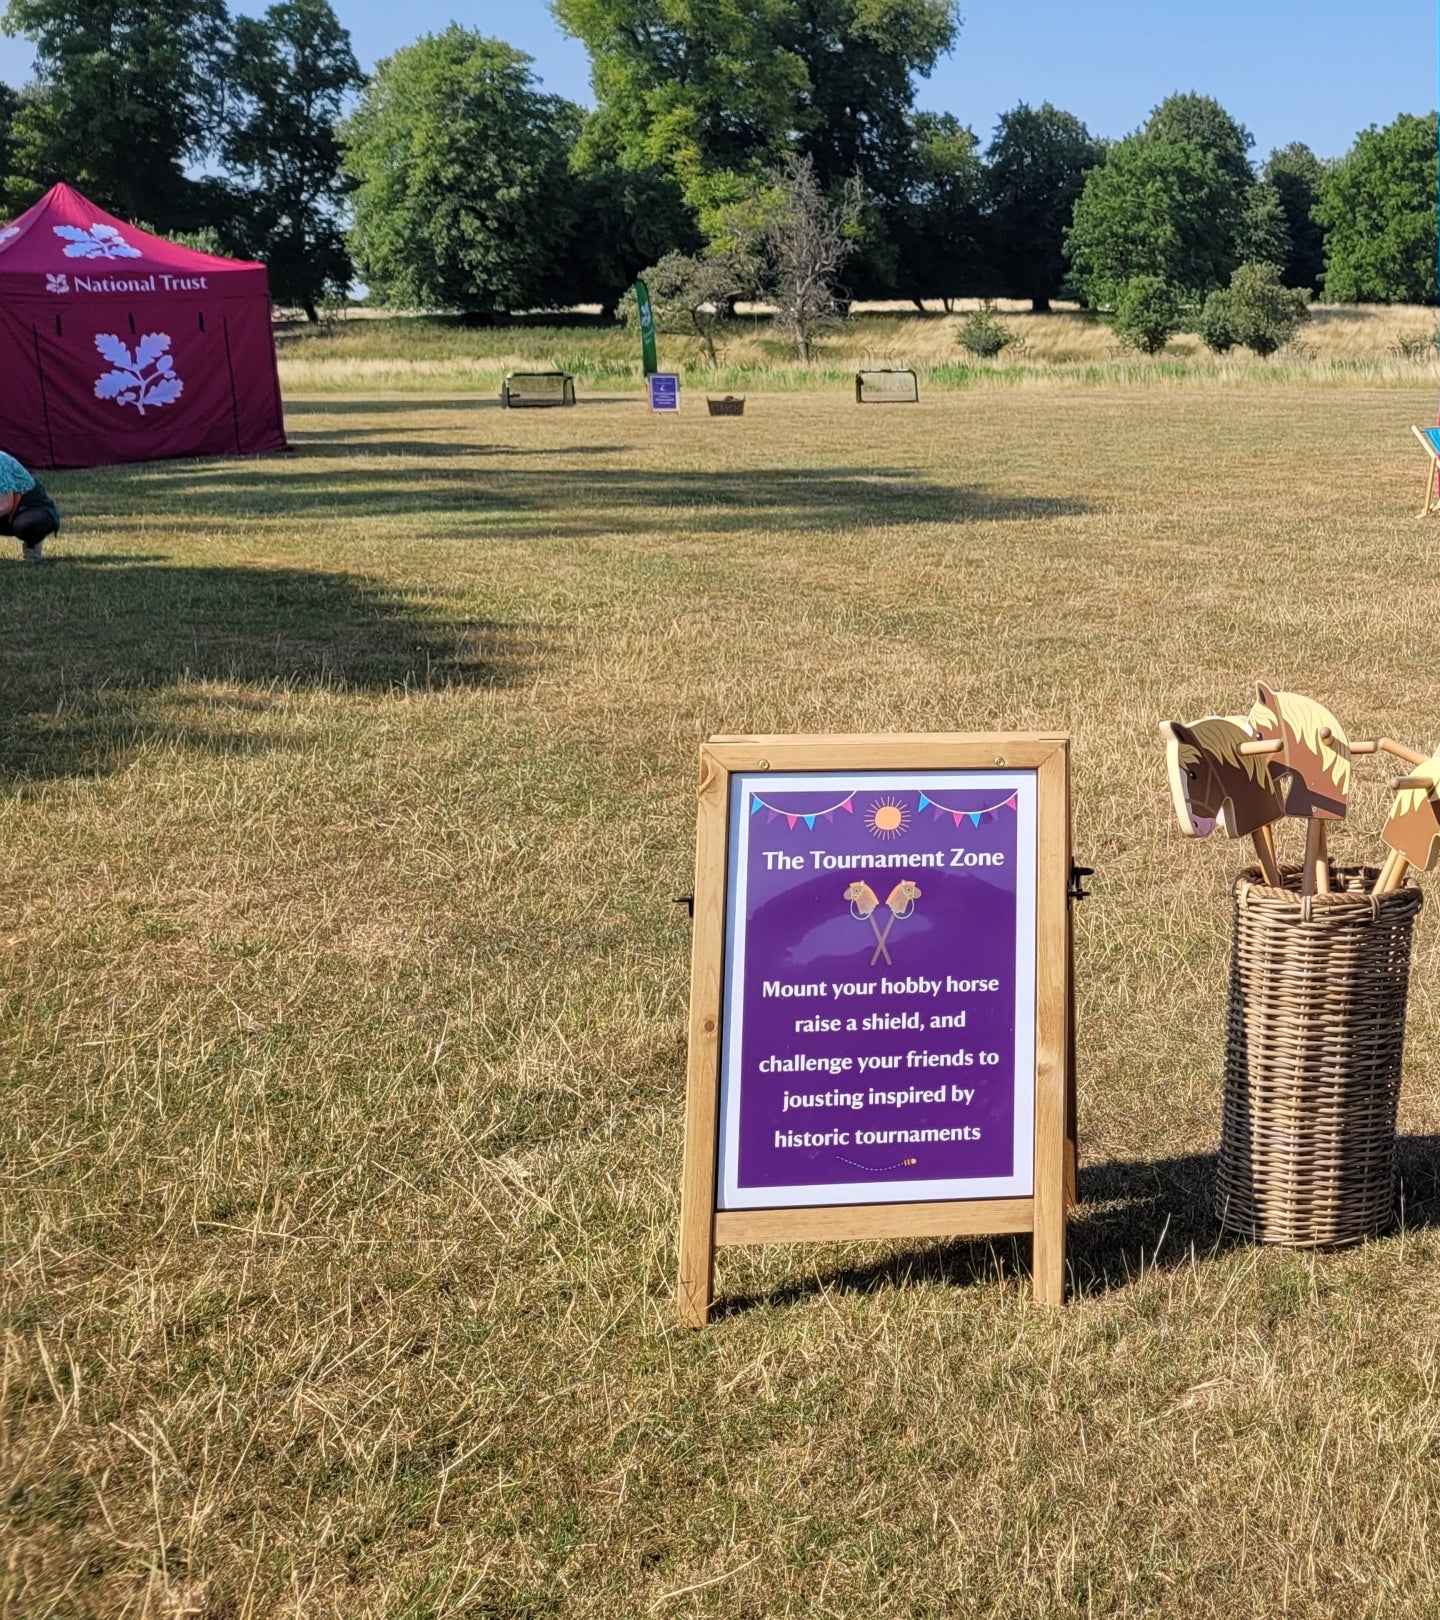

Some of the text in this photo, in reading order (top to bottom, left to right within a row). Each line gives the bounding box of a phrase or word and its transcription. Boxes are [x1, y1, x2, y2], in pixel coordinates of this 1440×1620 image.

[74, 274, 208, 292] National Trust
[761, 847, 1005, 871] The Tournament Zone
[762, 975, 1000, 1000] Mount your hobby horse
[795, 1010, 966, 1033] raise a shield, and
[758, 1048, 1000, 1075] challenge your friends to
[782, 1084, 975, 1113] jousting inspired by
[774, 1125, 981, 1148] historic tournaments
